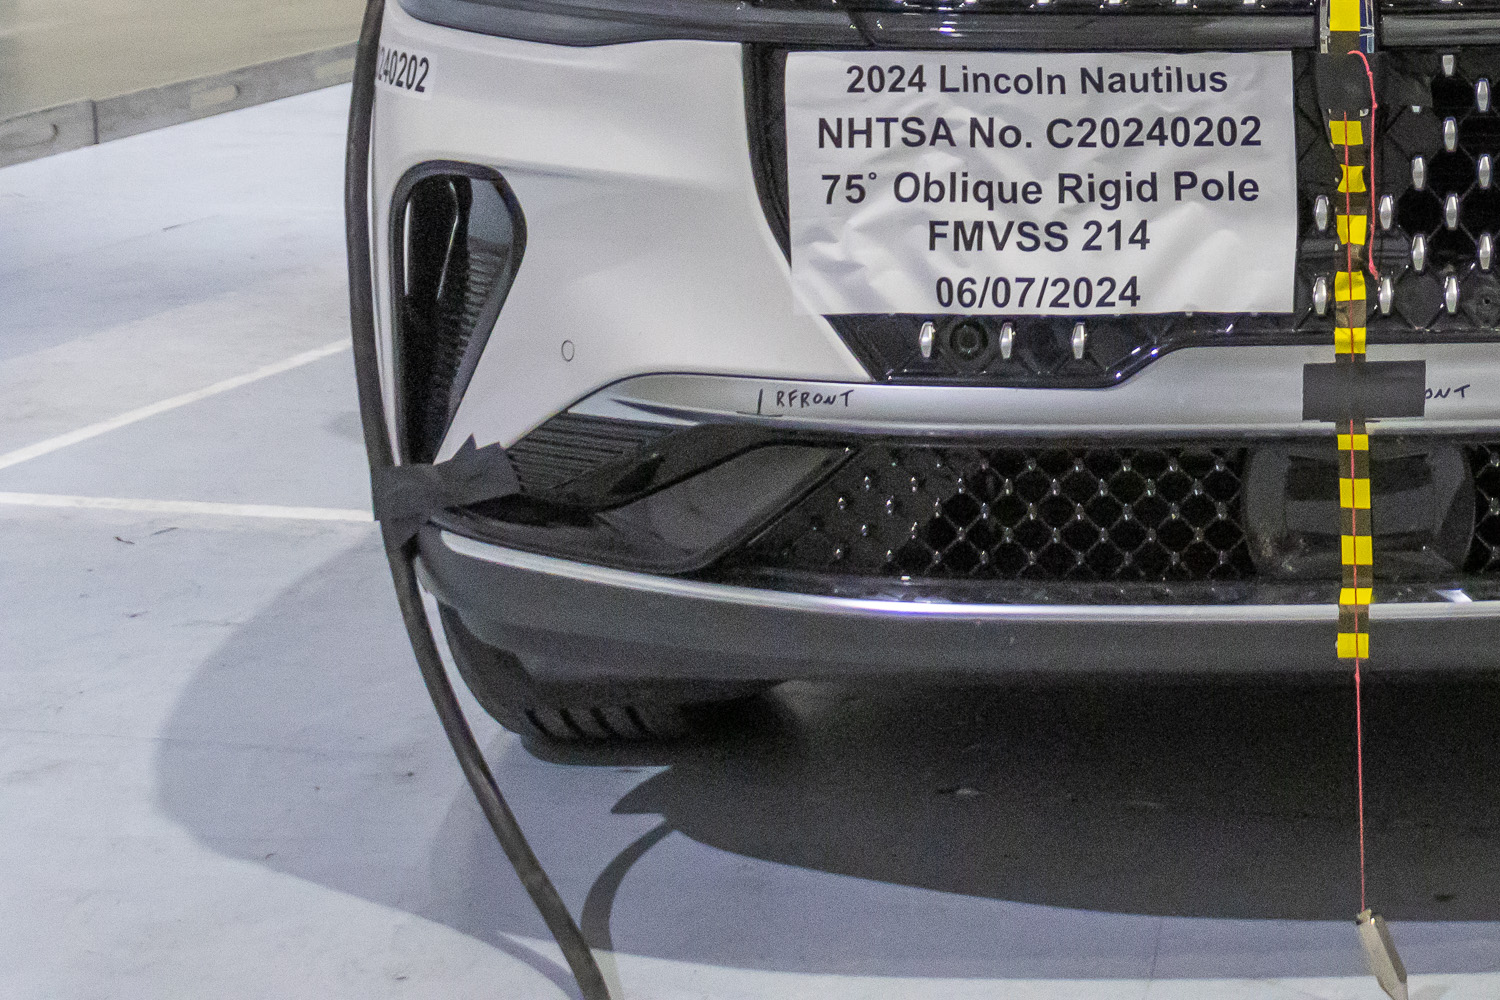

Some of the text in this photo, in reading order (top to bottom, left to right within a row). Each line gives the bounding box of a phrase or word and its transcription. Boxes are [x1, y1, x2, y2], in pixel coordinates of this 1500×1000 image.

[846, 64, 1228, 95] 2024 Lincoln Nautilus
[818, 115, 1262, 149] NHTSA No. C20240202
[821, 170, 1260, 211] 75° Oblique Rigid Pole
[928, 219, 1150, 253] FMVSS 214
[935, 275, 1141, 309] 06/07/2024
